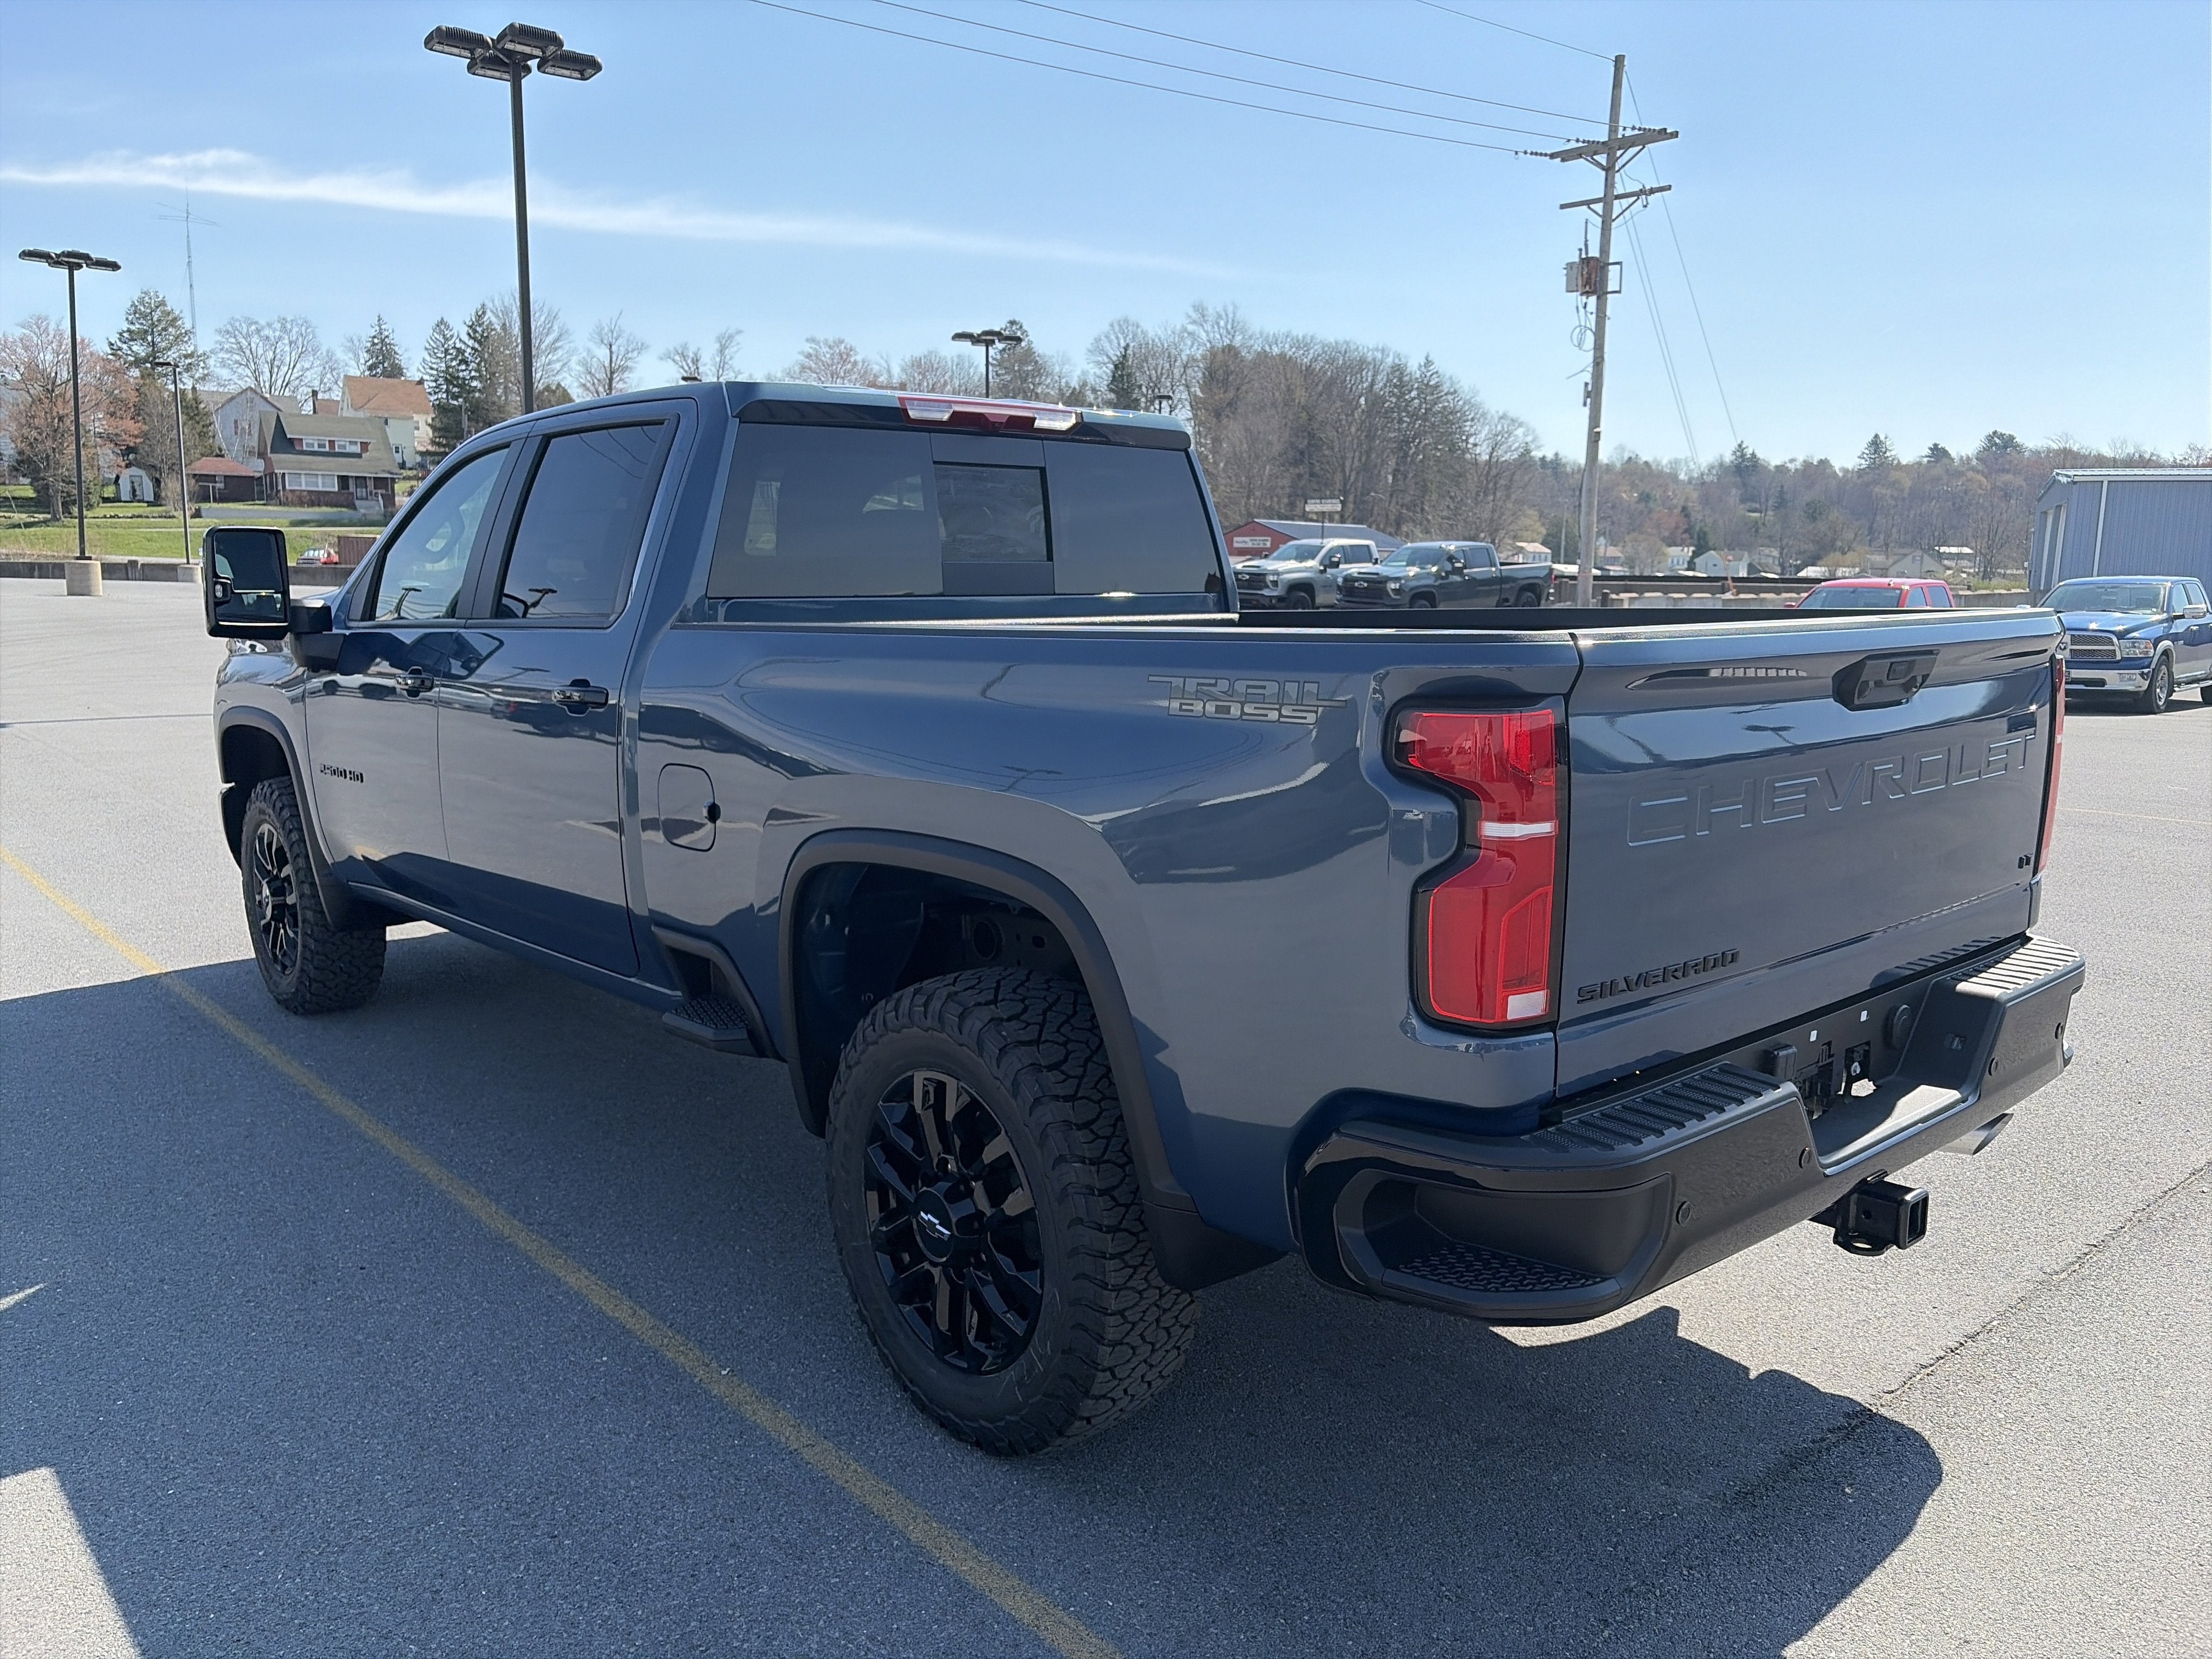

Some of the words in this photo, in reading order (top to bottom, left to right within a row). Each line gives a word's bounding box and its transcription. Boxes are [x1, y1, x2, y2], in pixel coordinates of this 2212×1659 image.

[1148, 675, 1347, 708] TRAIL
[1168, 697, 1318, 725] BOSS
[1627, 732, 2036, 847] CHEVROLET
[1576, 948, 1740, 1004] SILVERADO
